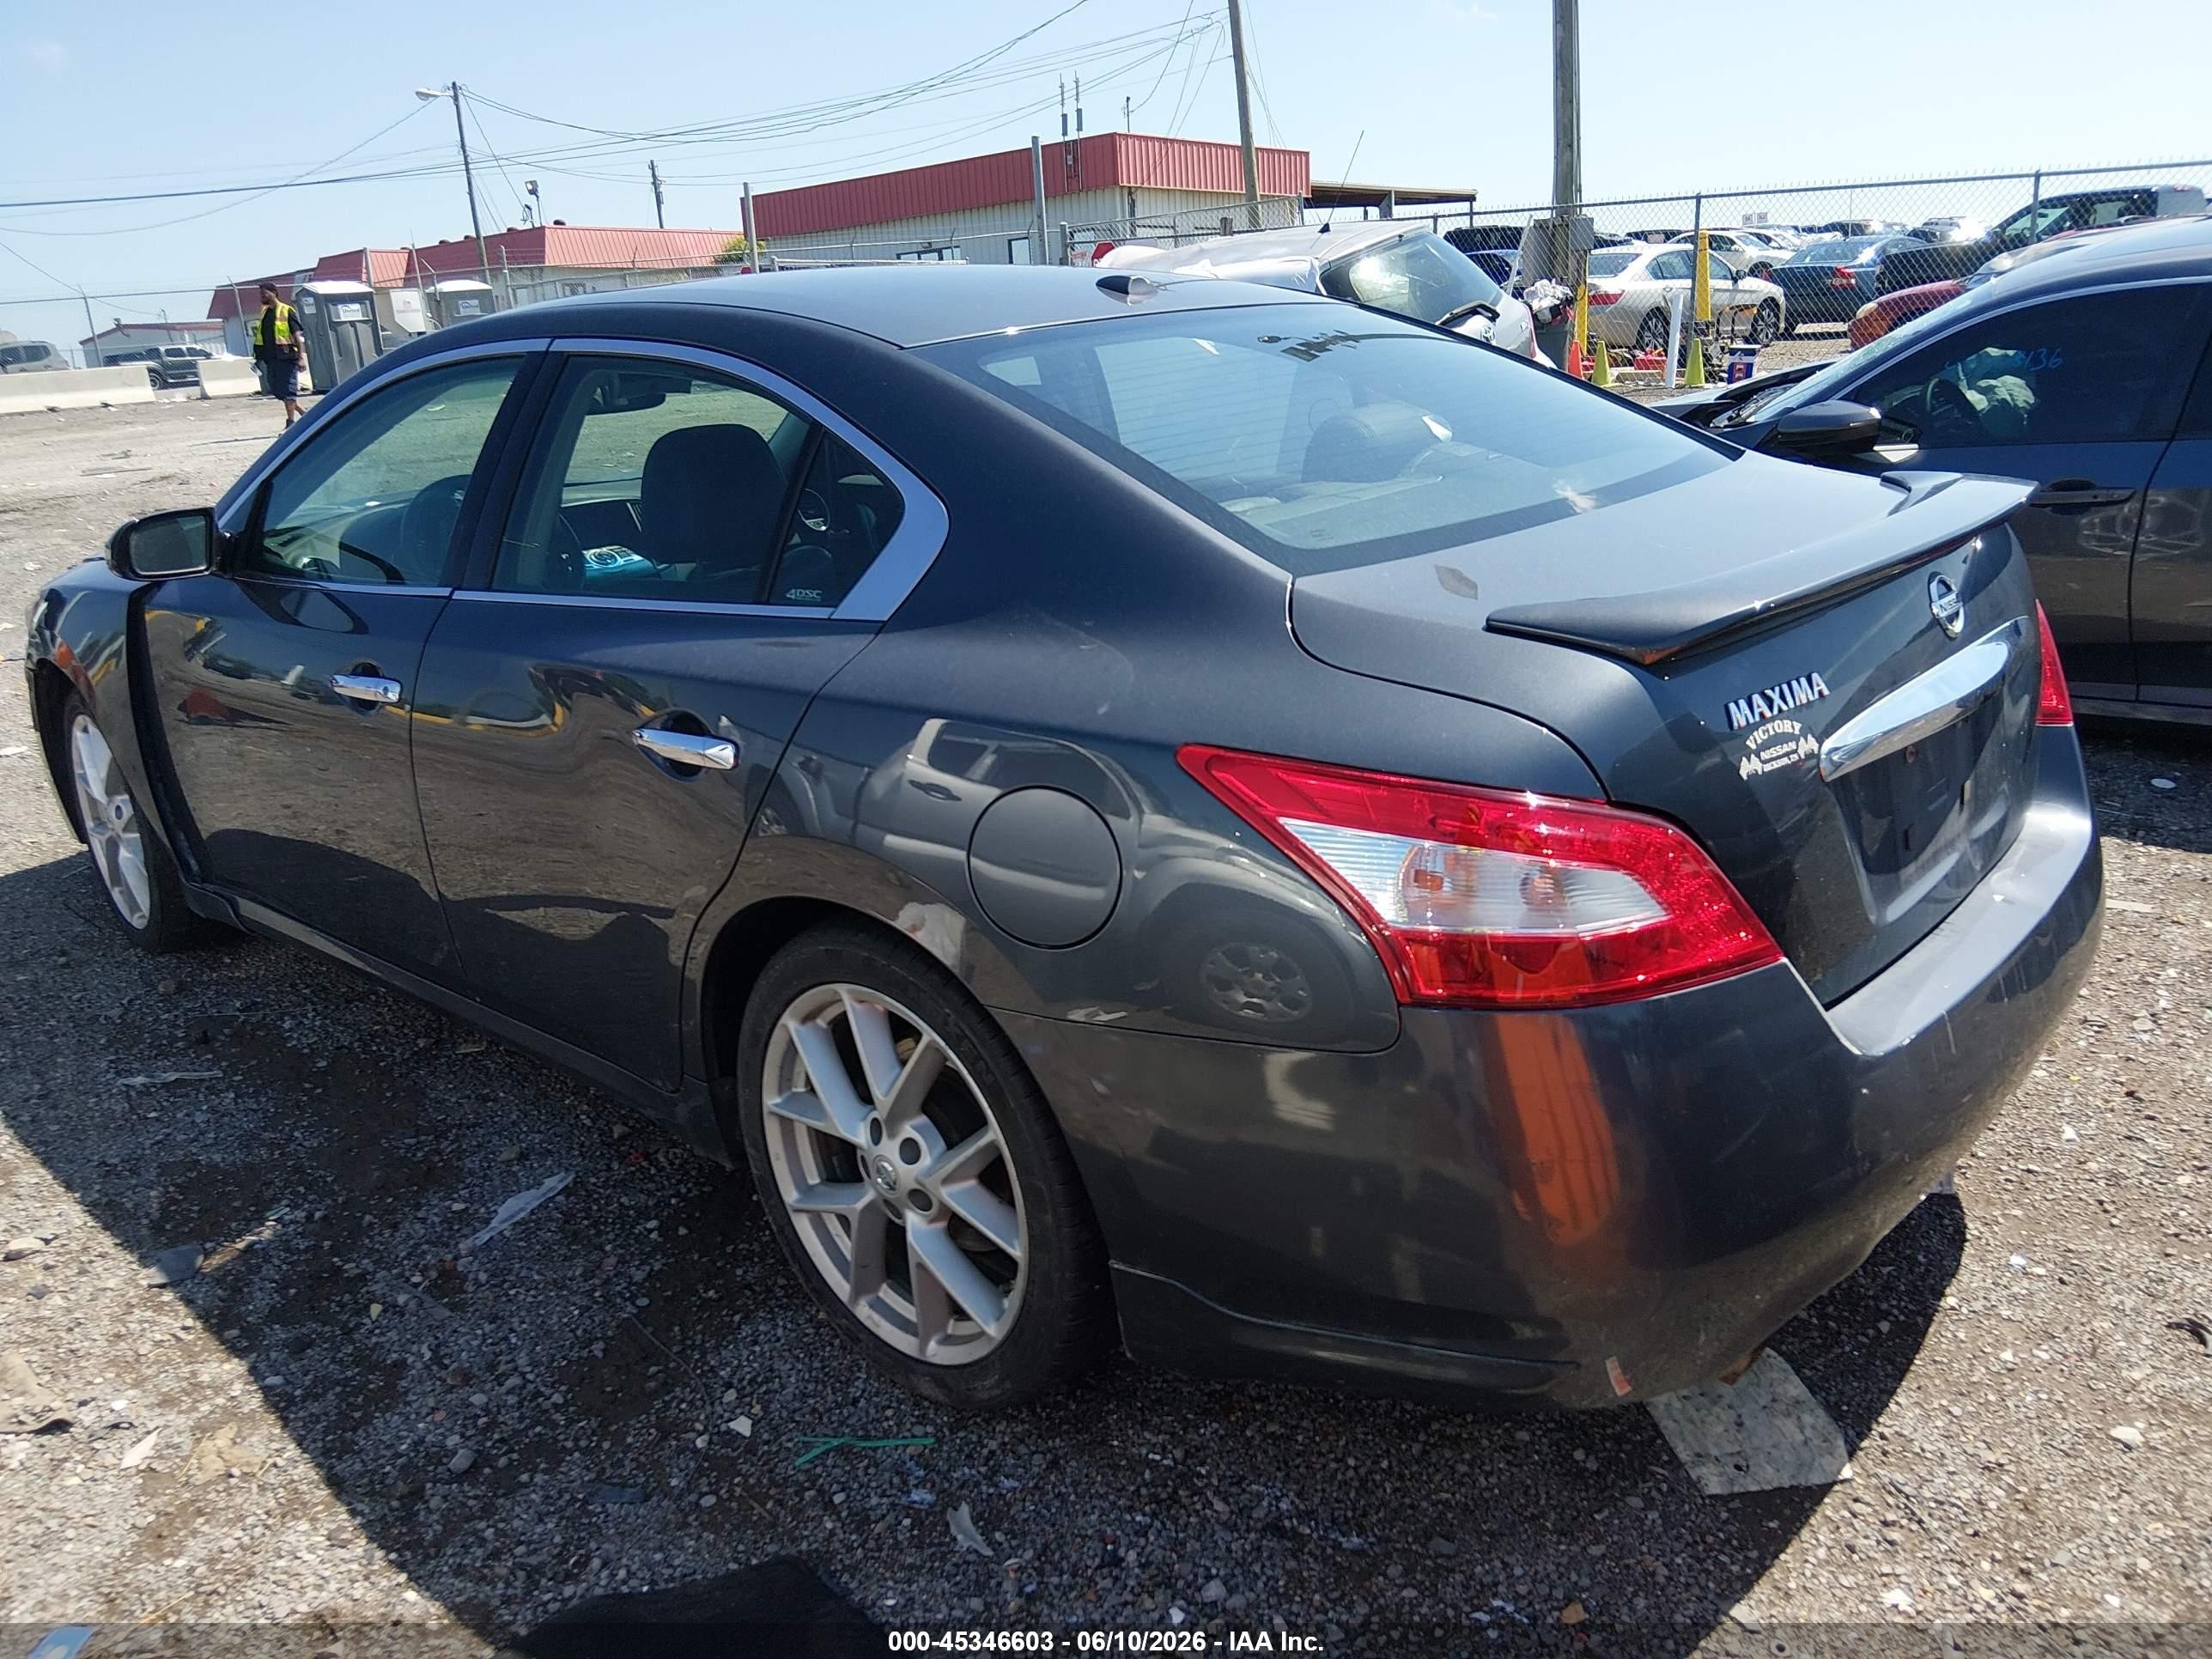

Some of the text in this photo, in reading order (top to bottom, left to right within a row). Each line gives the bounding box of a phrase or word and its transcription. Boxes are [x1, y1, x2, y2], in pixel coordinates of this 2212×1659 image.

[1725, 672, 1830, 730] MAXIMA
[1745, 719, 1802, 750] VICTORY
[1759, 740, 1797, 761] NISSAN
